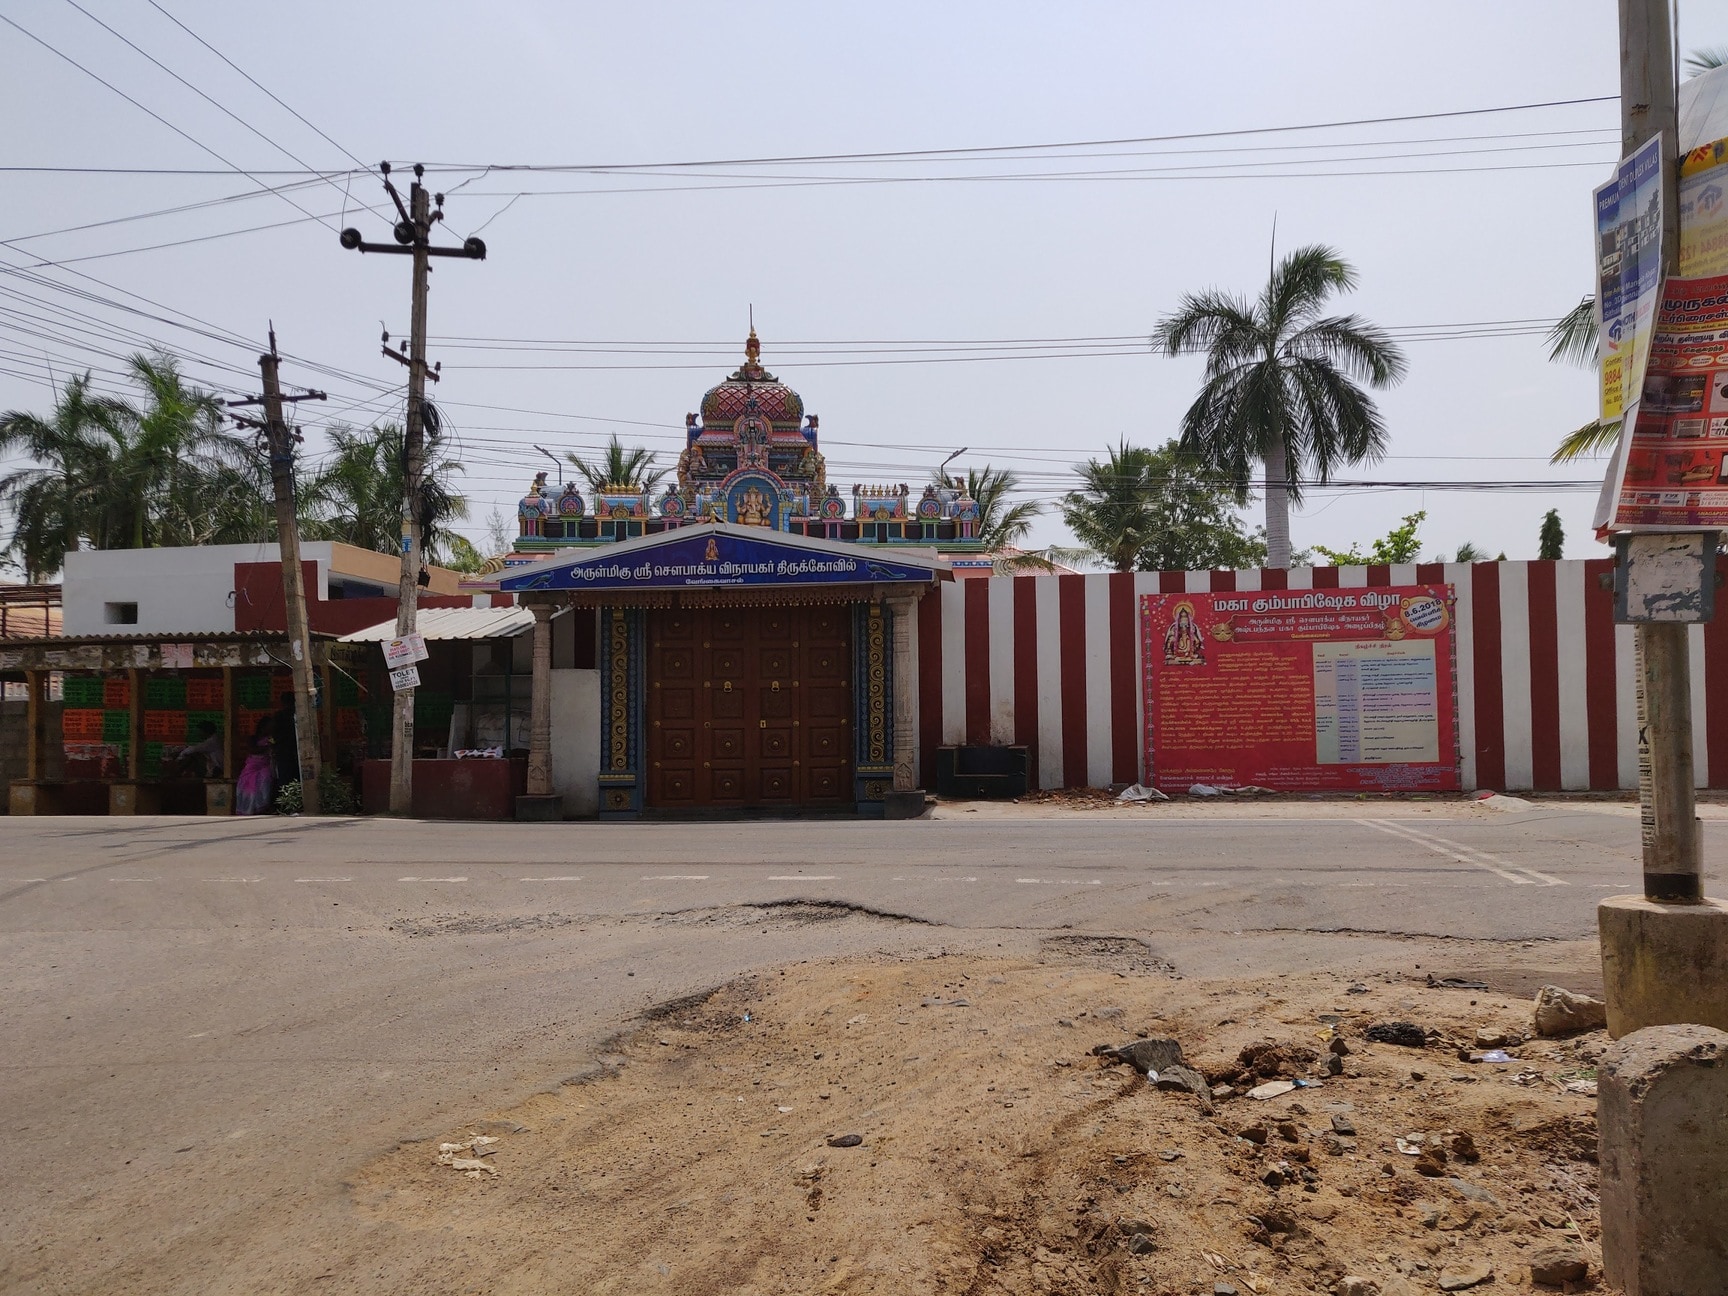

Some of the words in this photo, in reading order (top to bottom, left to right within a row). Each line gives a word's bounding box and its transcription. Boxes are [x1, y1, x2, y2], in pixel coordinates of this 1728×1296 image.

[569, 564, 632, 581] அருள்மிகு
[718, 558, 775, 576] விநாயகர்
[777, 557, 857, 575] திருக்கோவில்
[1213, 599, 1249, 613] மகா
[1252, 593, 1356, 614] கும்பாபிஷேக
[1360, 591, 1401, 612] விழா
